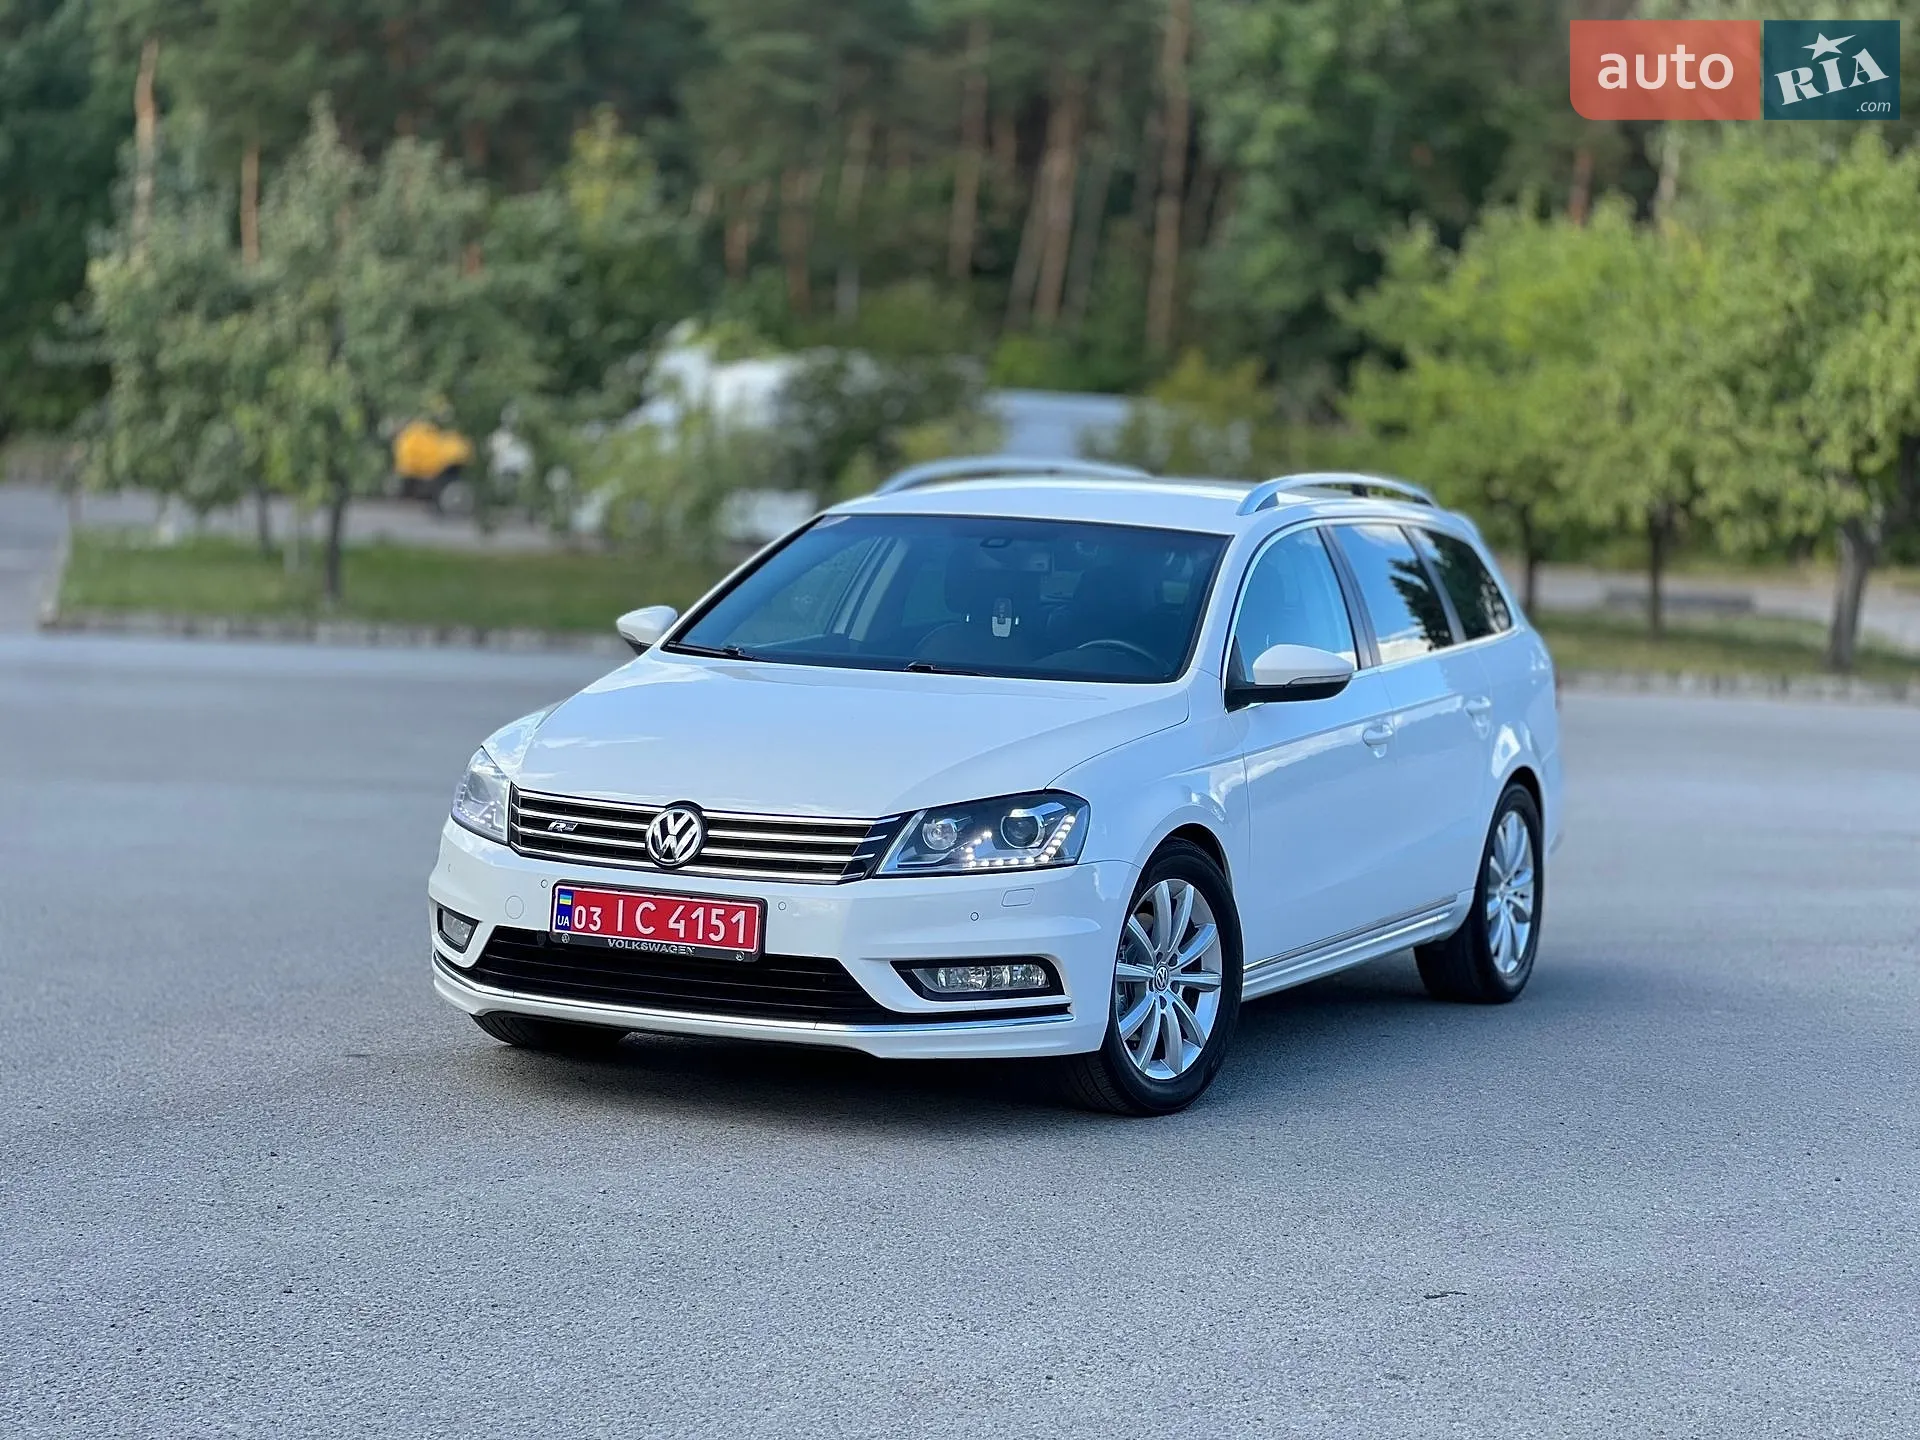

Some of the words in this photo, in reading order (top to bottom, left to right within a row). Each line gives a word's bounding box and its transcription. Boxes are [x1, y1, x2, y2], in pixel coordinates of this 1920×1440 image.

[557, 914, 570, 927] UA
[573, 905, 602, 932] 03
[616, 899, 656, 935] IC
[668, 904, 747, 944] 4151
[607, 938, 696, 956] VOLKSWAGEN
